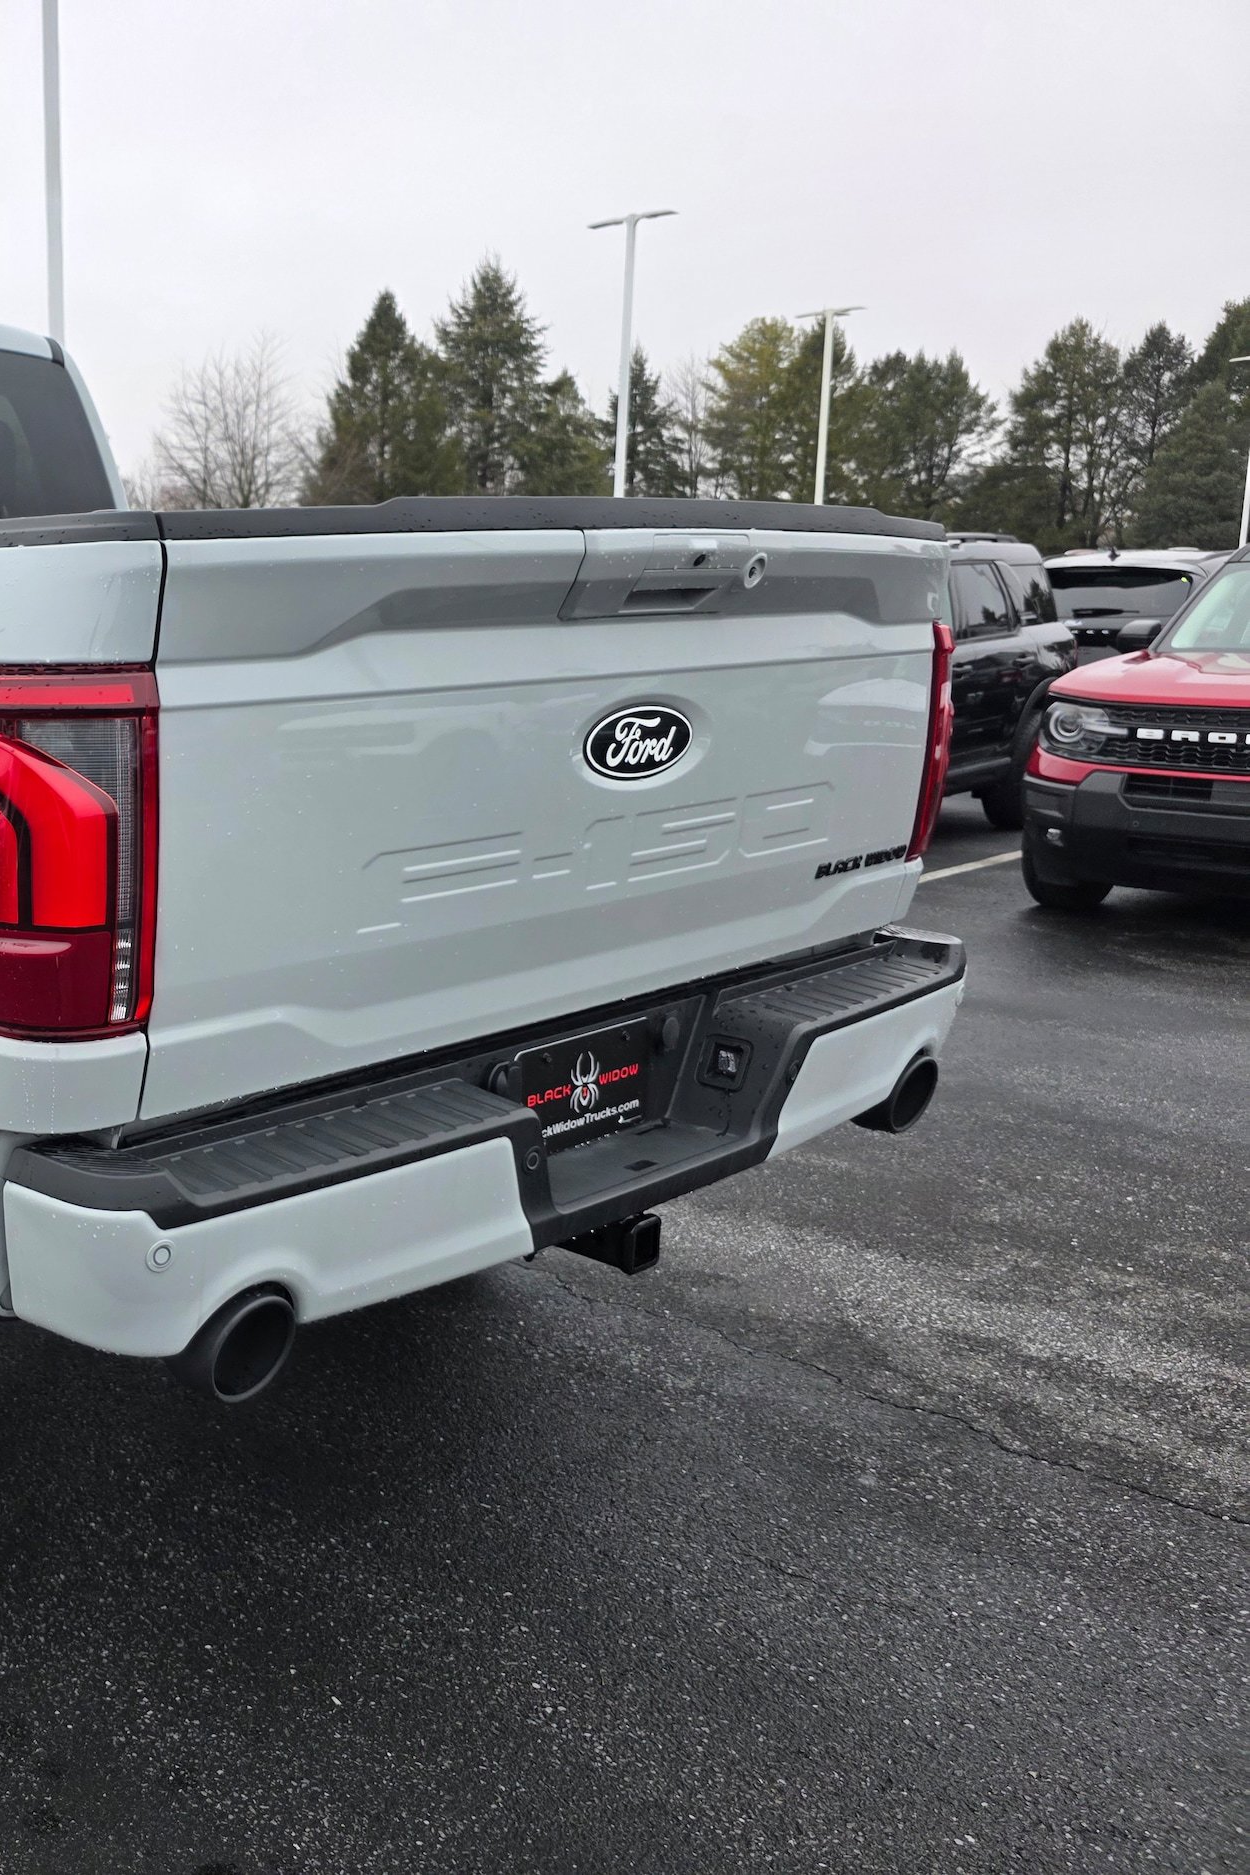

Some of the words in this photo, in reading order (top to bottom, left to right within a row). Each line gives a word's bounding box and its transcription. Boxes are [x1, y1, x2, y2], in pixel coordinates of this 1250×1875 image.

[606, 717, 677, 767] Ford
[356, 780, 835, 934] F-150
[815, 855, 864, 879] BLACK
[527, 1084, 572, 1107] BLACK
[598, 1063, 639, 1085] WIDOW
[541, 1099, 640, 1138] ckWidowTrucks.com
